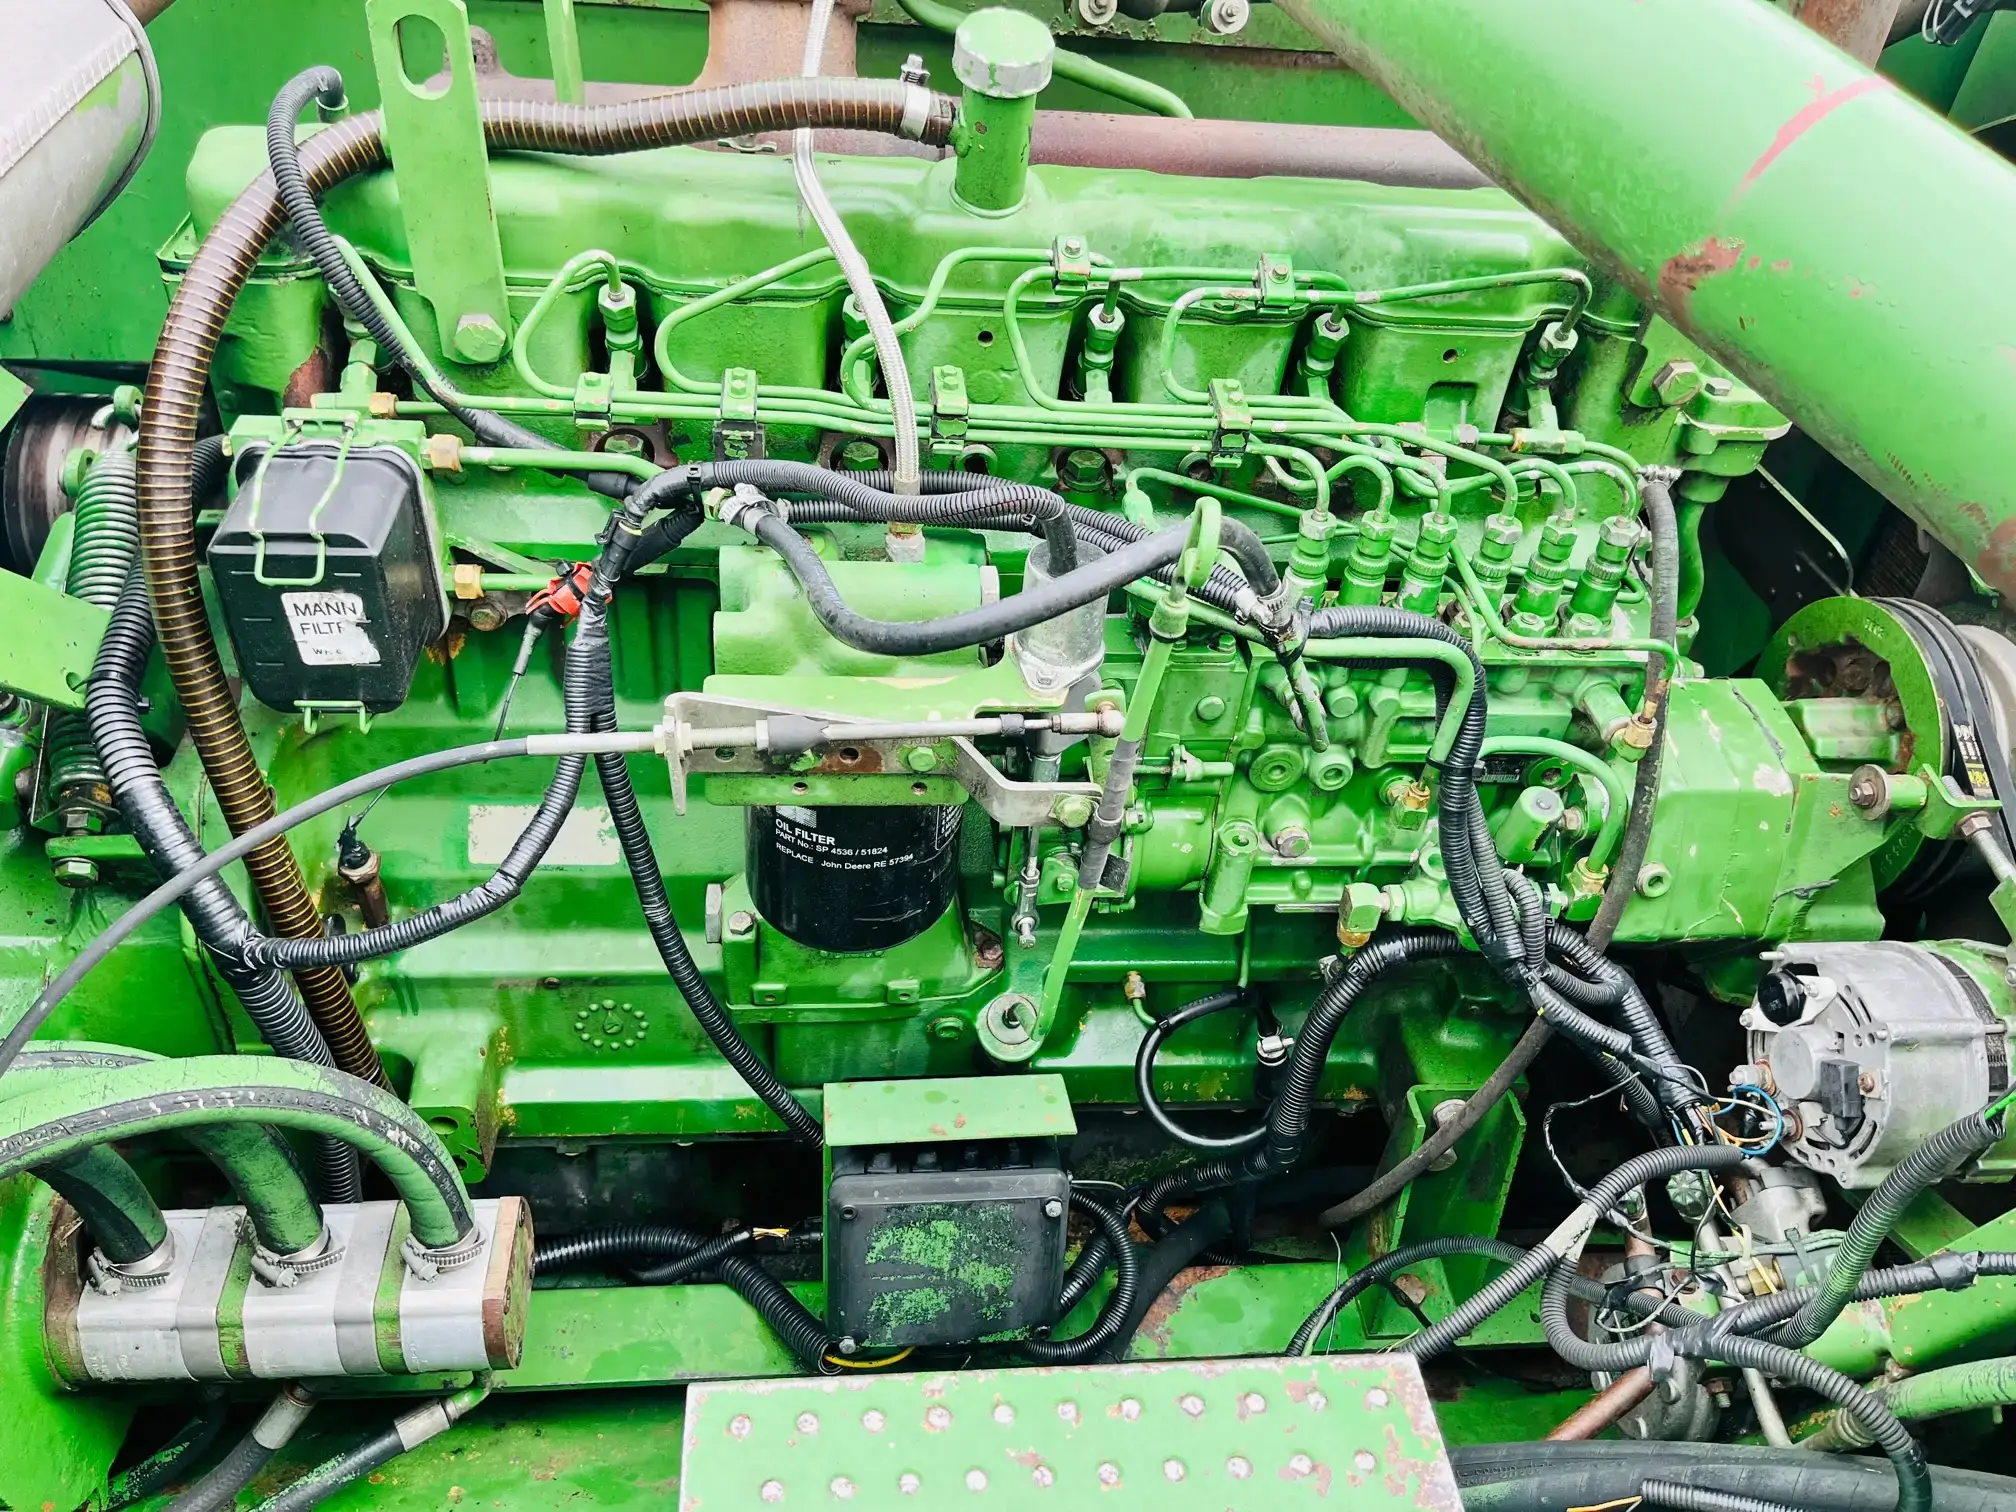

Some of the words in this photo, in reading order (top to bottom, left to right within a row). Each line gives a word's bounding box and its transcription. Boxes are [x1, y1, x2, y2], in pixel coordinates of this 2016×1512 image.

[293, 602, 357, 616] MANN
[776, 819, 792, 834] OIL
[795, 828, 835, 846] FILTER
[776, 828, 795, 843] PART
[815, 845, 829, 853] SP
[860, 847, 888, 856] 51824
[776, 842, 814, 864] REPLACE
[821, 860, 842, 869] John
[844, 862, 871, 870] Deere
[889, 853, 914, 866] 57394
